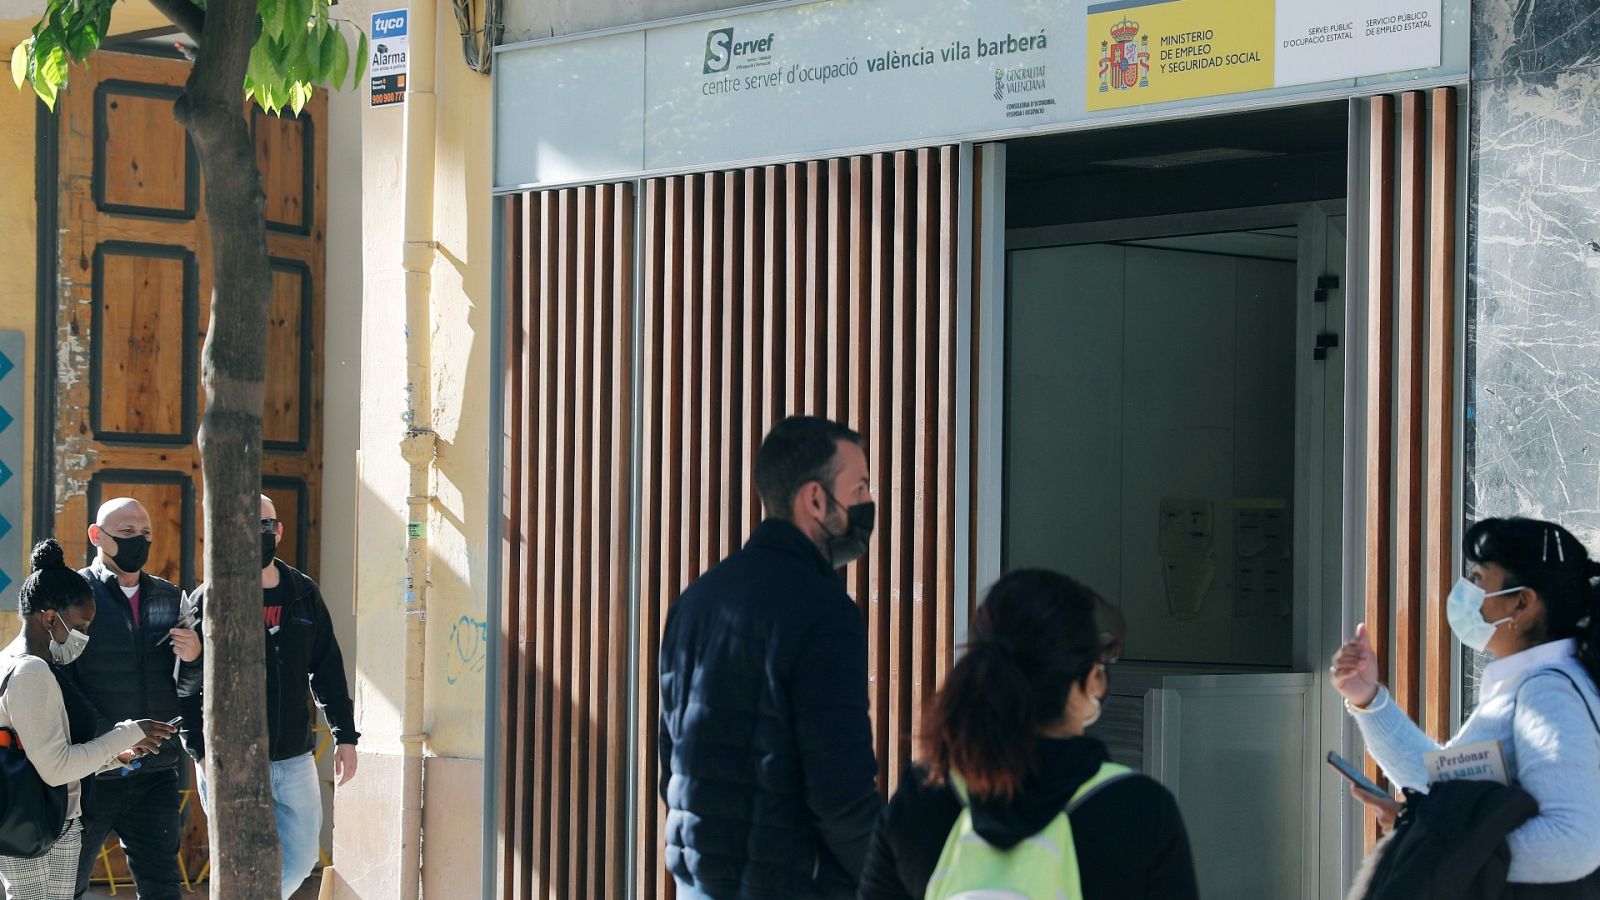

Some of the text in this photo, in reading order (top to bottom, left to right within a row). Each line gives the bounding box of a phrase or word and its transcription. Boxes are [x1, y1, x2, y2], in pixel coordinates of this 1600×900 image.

[374, 17, 404, 34] tyco
[1365, 20, 1432, 36] DE EMPLEO ESTATAL
[1366, 16, 1397, 28] SERVICIO
[1160, 29, 1214, 47] MINISTERIO
[1308, 26, 1329, 36] SERVEI
[1326, 32, 1353, 42] ESTATAL
[372, 52, 406, 66] Alarma
[706, 31, 775, 71] Servef
[1160, 43, 1212, 61] DE EMPLEO
[702, 29, 1048, 96] centre servef d'ocupació valència vila barberá
[1160, 51, 1261, 74] Y SEGURIDAD SOCIAL
[1006, 65, 1046, 82] GENERALITAT
[1006, 79, 1046, 94] VALENCIANA
